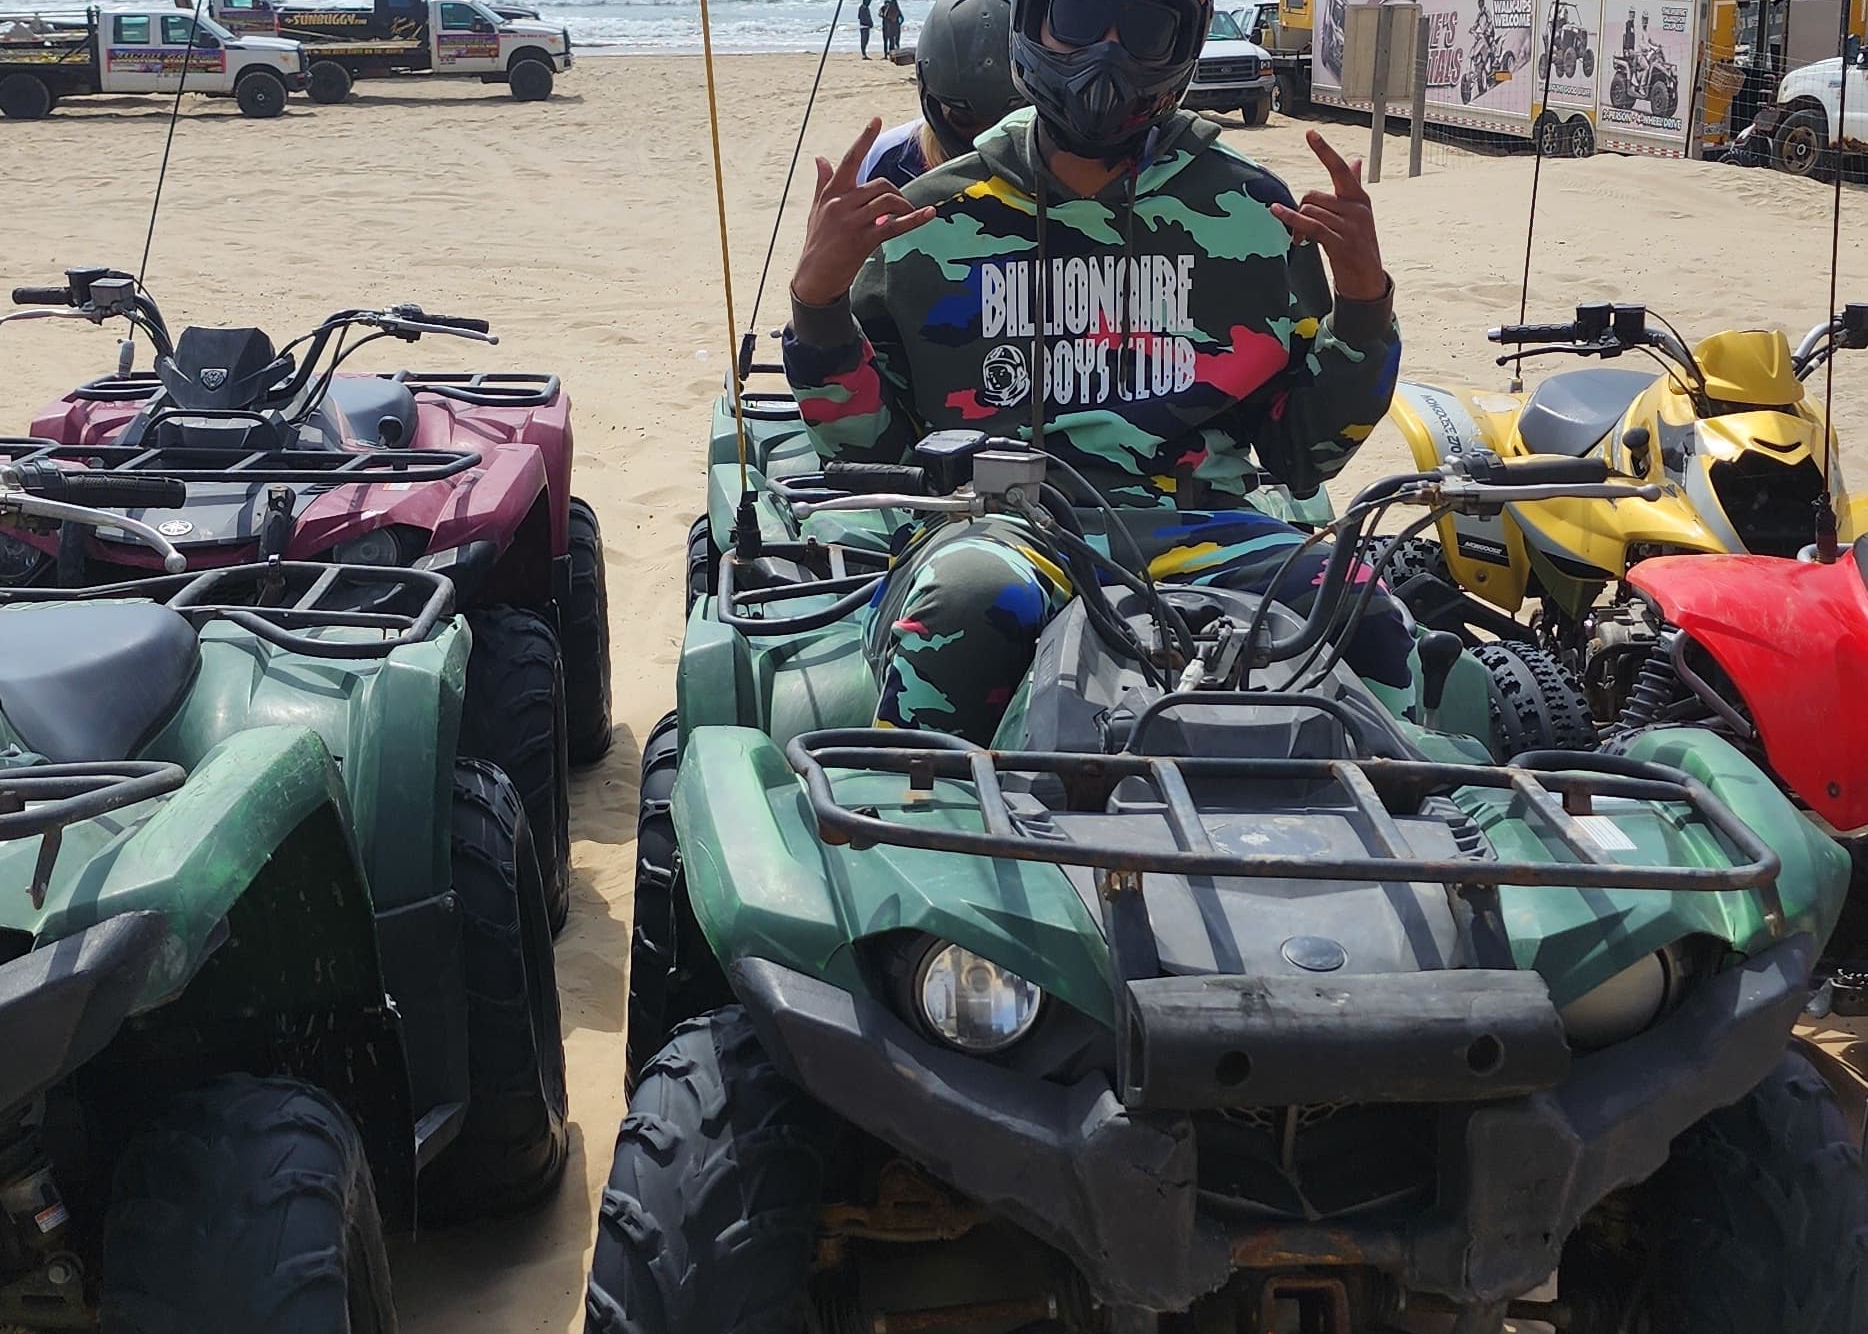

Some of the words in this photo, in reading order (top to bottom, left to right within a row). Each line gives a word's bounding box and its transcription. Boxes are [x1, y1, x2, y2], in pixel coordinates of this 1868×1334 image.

[1494, 13, 1531, 28] WELCOME
[1663, 117, 1683, 131] DRIVE
[981, 254, 1195, 339] BILLIONAIRE
[1031, 338, 1110, 405] BOYS
[1117, 336, 1196, 401] CLUB
[1446, 435, 1463, 454] 270
